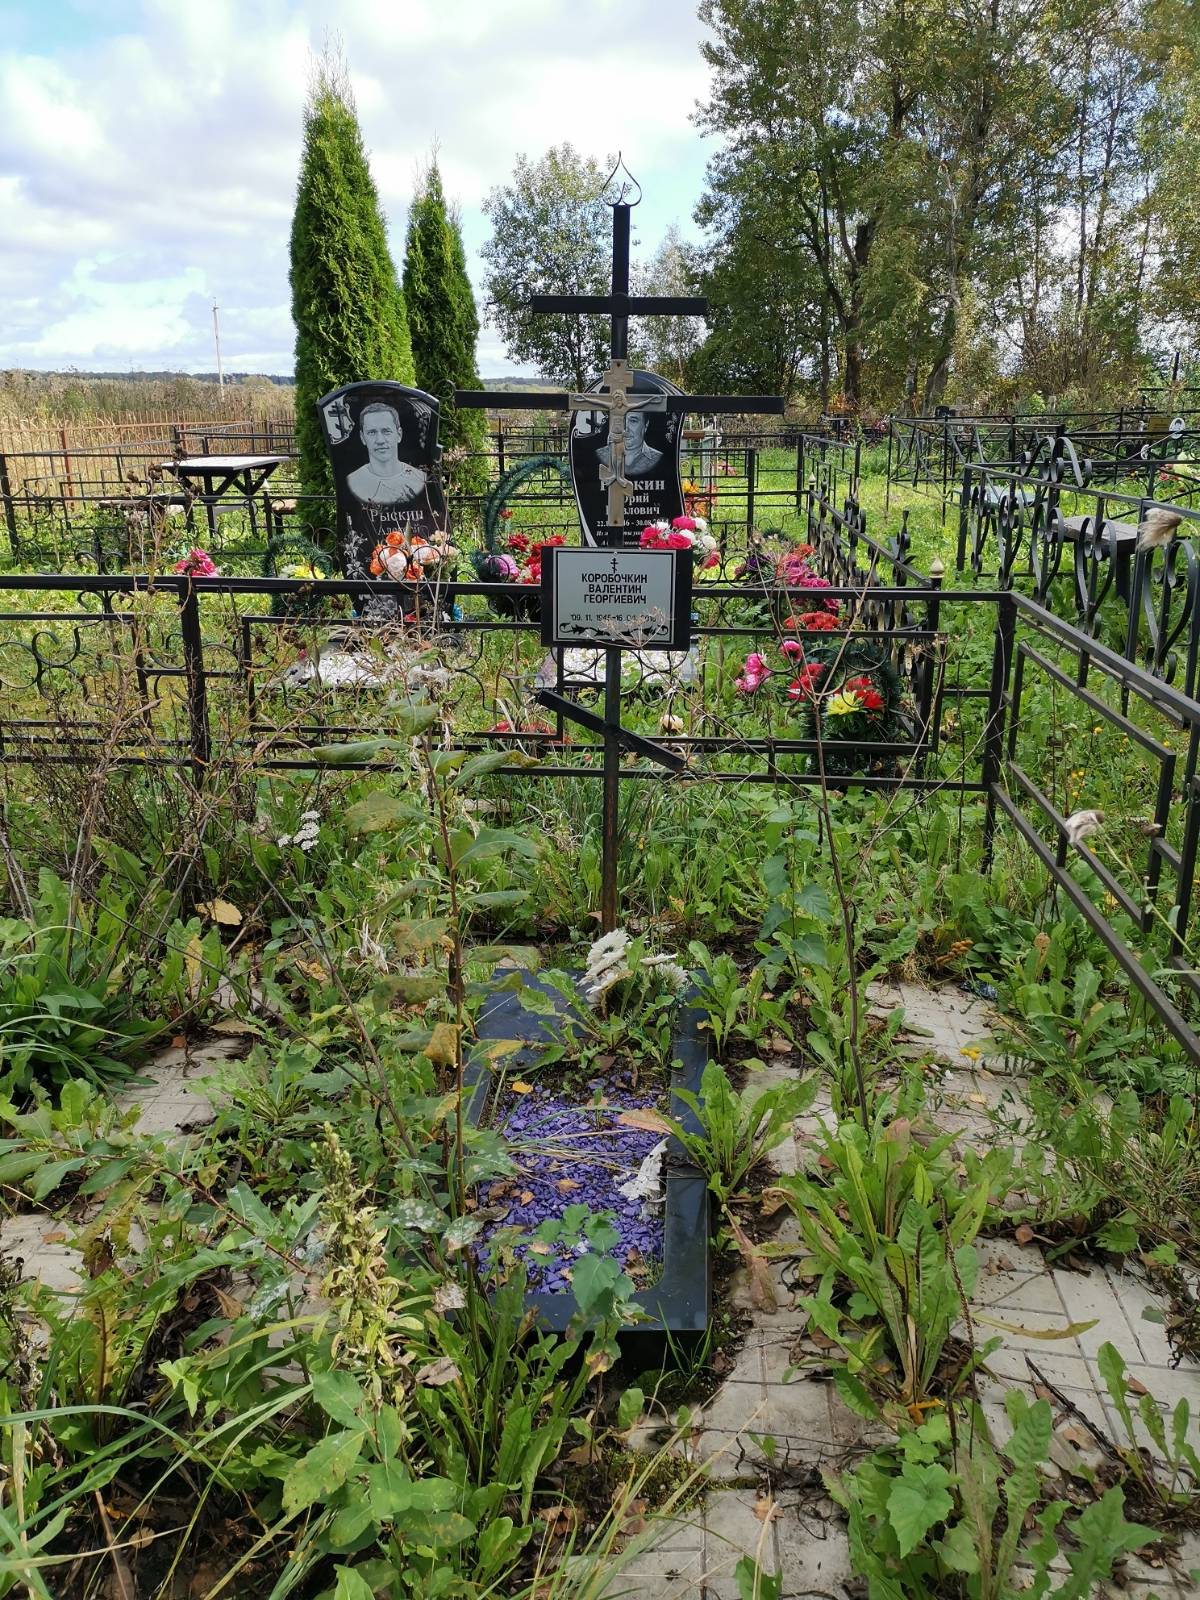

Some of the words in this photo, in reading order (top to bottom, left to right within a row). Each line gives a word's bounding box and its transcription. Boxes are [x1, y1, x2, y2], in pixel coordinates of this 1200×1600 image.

[581, 573, 648, 584] КОРОБОЧКИН
[588, 584, 642, 594] ВАЛЕНТИН
[584, 594, 647, 604] ГЕОРГИЕВИЧ
